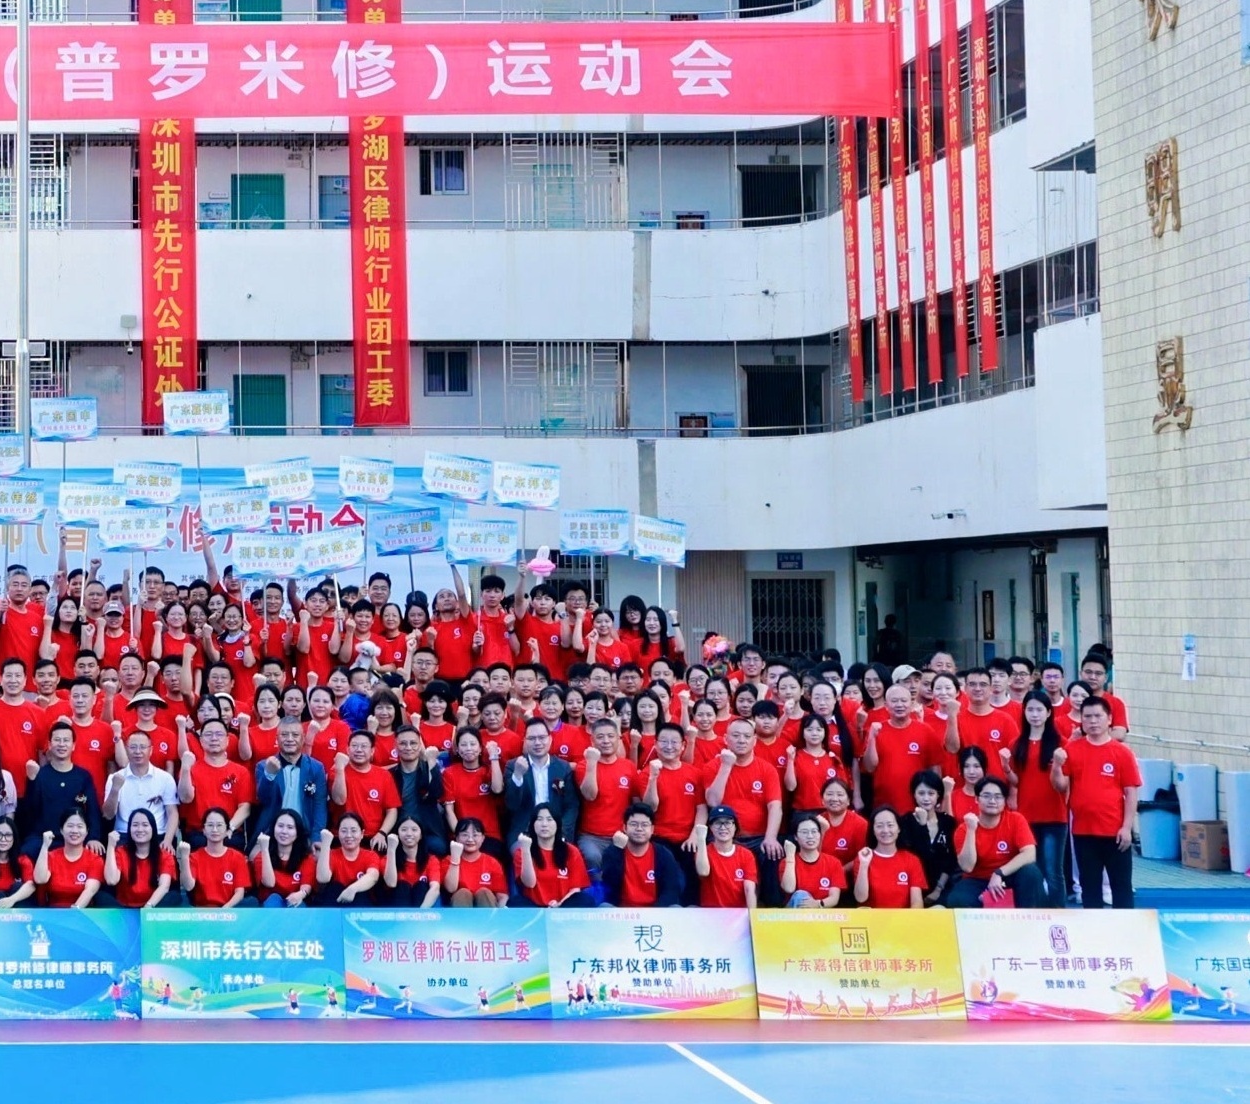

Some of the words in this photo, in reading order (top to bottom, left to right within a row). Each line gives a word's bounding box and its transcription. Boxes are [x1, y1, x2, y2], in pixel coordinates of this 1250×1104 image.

[868, 117, 887, 348] 东嘉得信律师事务所
[160, 941, 325, 961] 深圳市先行公证处
[361, 940, 531, 963] 罗湖区律师行业团工委
[572, 958, 731, 973] 广东邦仪律师事务所
[783, 958, 933, 973] 广东嘉得信律师事务所
[991, 957, 1133, 972] 广东一言律师事务所
[12, 979, 65, 990] 总冠名单位
[223, 974, 264, 985] 承办单位
[427, 977, 469, 987] 协办单位
[632, 978, 673, 988] 赞助单位
[839, 979, 880, 989] 赞助单位
[1045, 980, 1086, 989] 赞助单位
